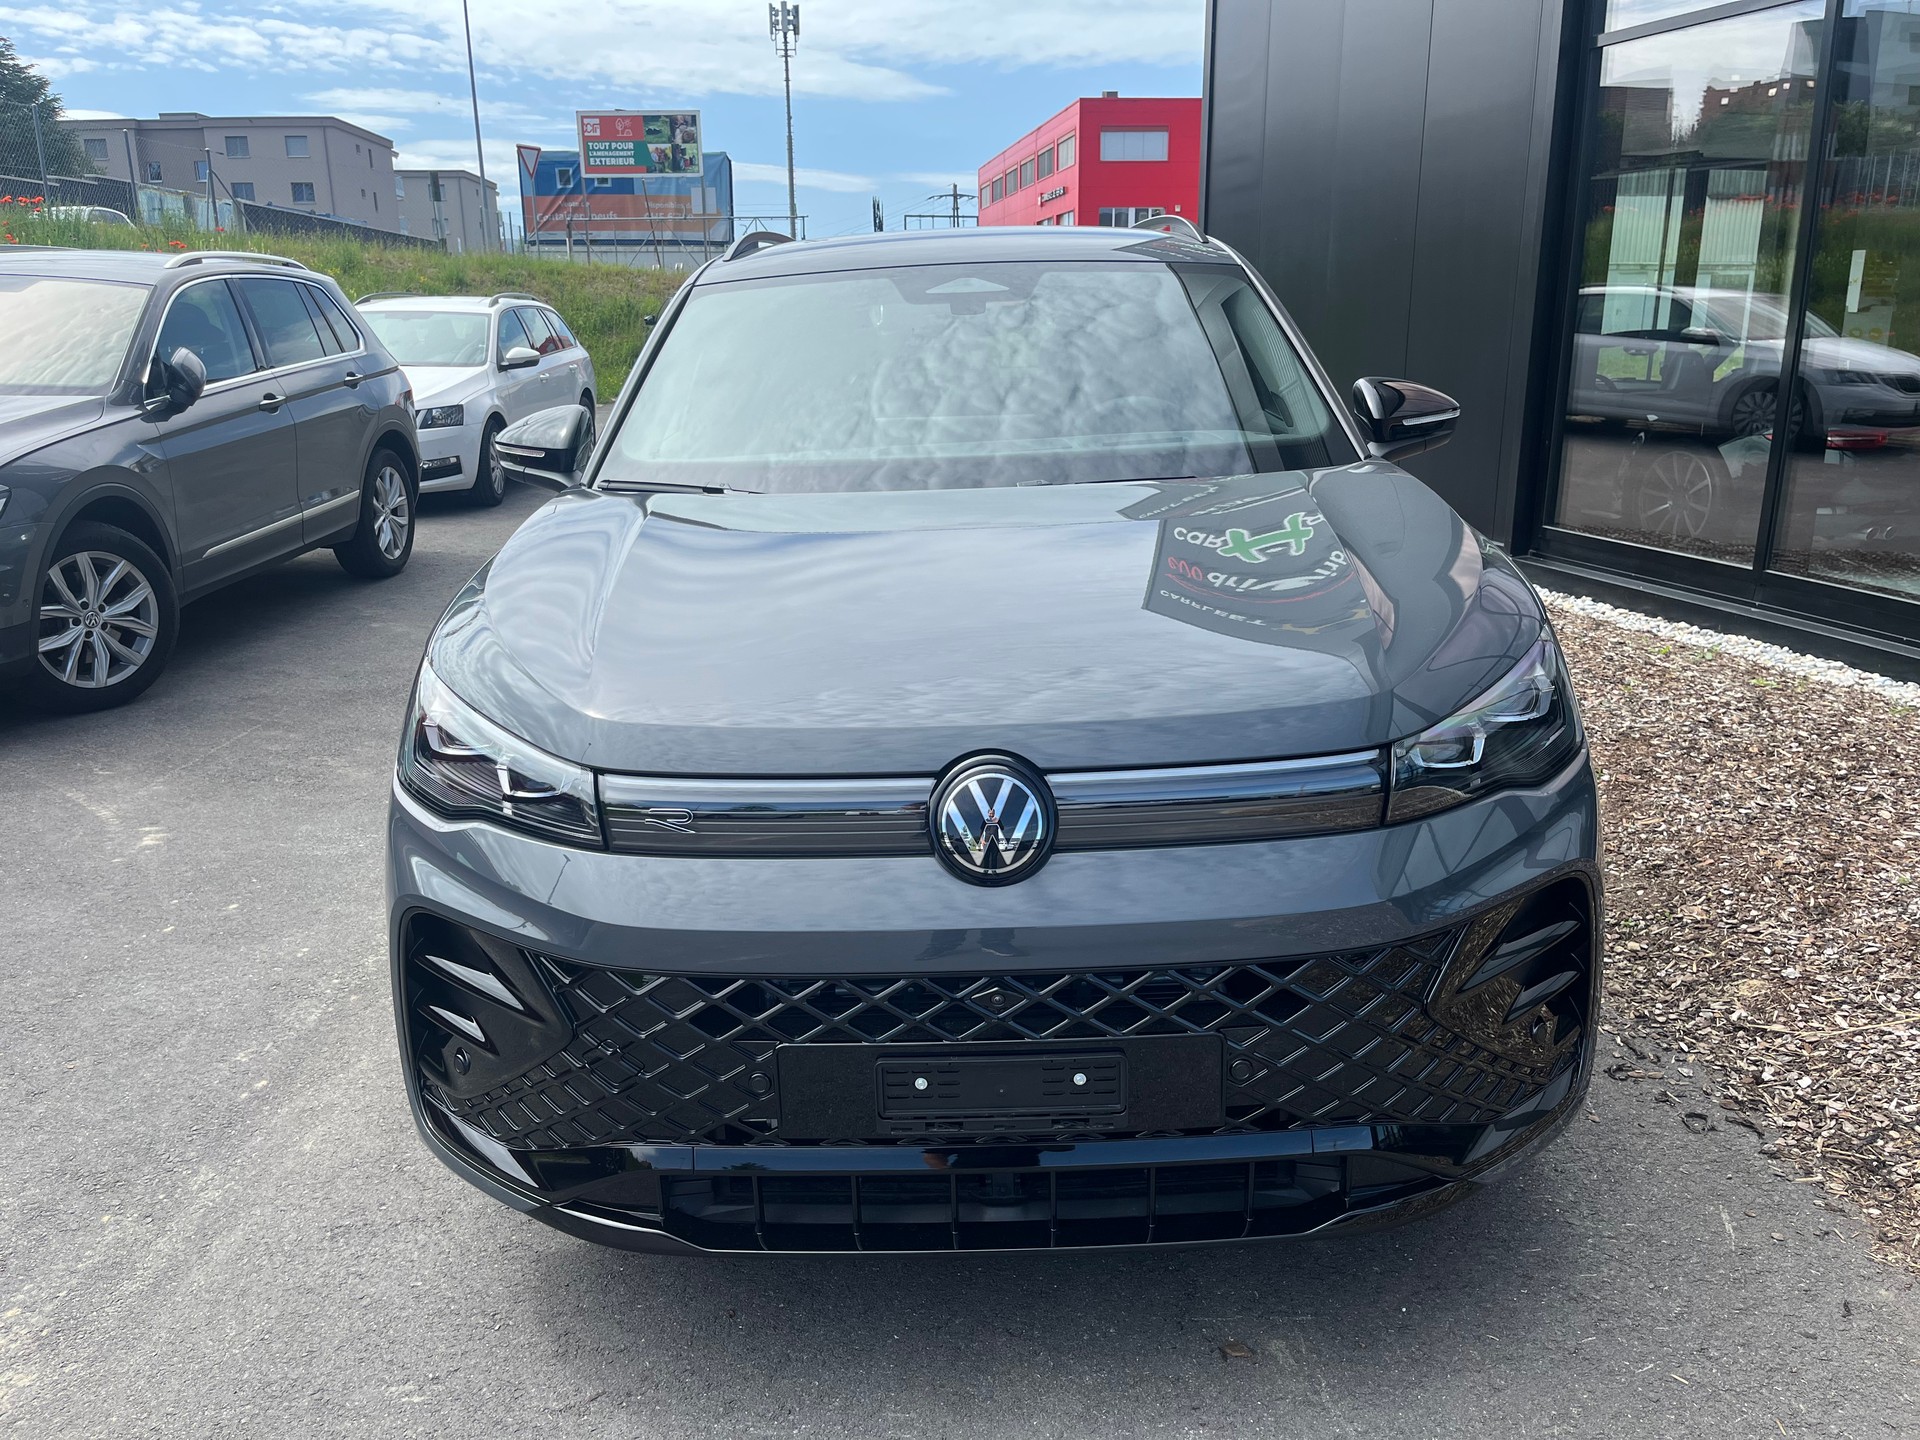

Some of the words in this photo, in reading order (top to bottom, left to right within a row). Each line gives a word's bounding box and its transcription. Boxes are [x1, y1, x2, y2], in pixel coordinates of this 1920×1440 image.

[587, 142, 610, 150] TOUT
[611, 142, 634, 150] POUR
[589, 157, 636, 165] EXTERIEUR
